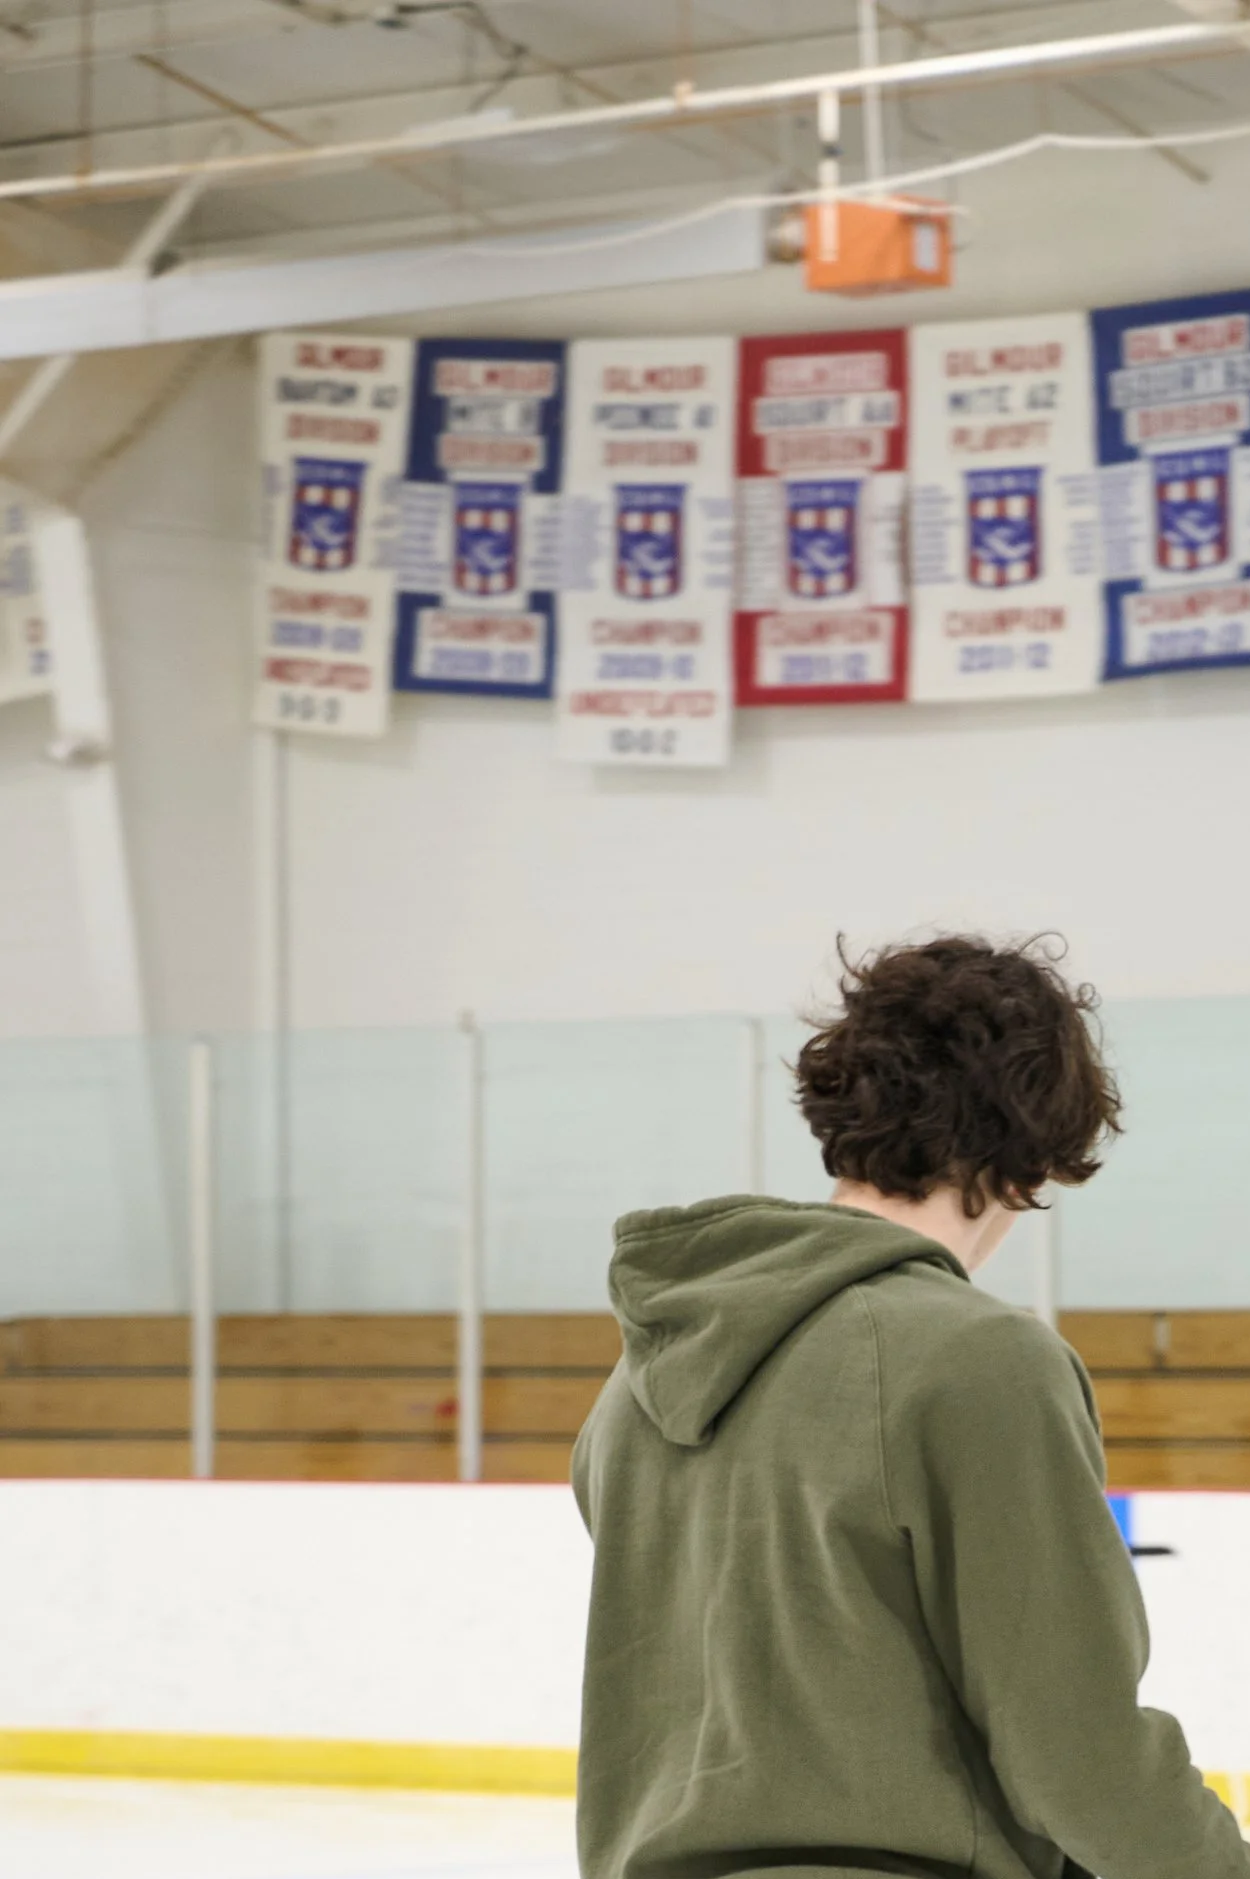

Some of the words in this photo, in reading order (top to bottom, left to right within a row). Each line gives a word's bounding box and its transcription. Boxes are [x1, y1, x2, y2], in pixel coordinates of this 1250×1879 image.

[1129, 320, 1246, 360] GILMOUR
[945, 343, 1063, 379] GILMOUR
[1137, 401, 1239, 438] DIVISION
[944, 606, 1066, 639] CHAMPION
